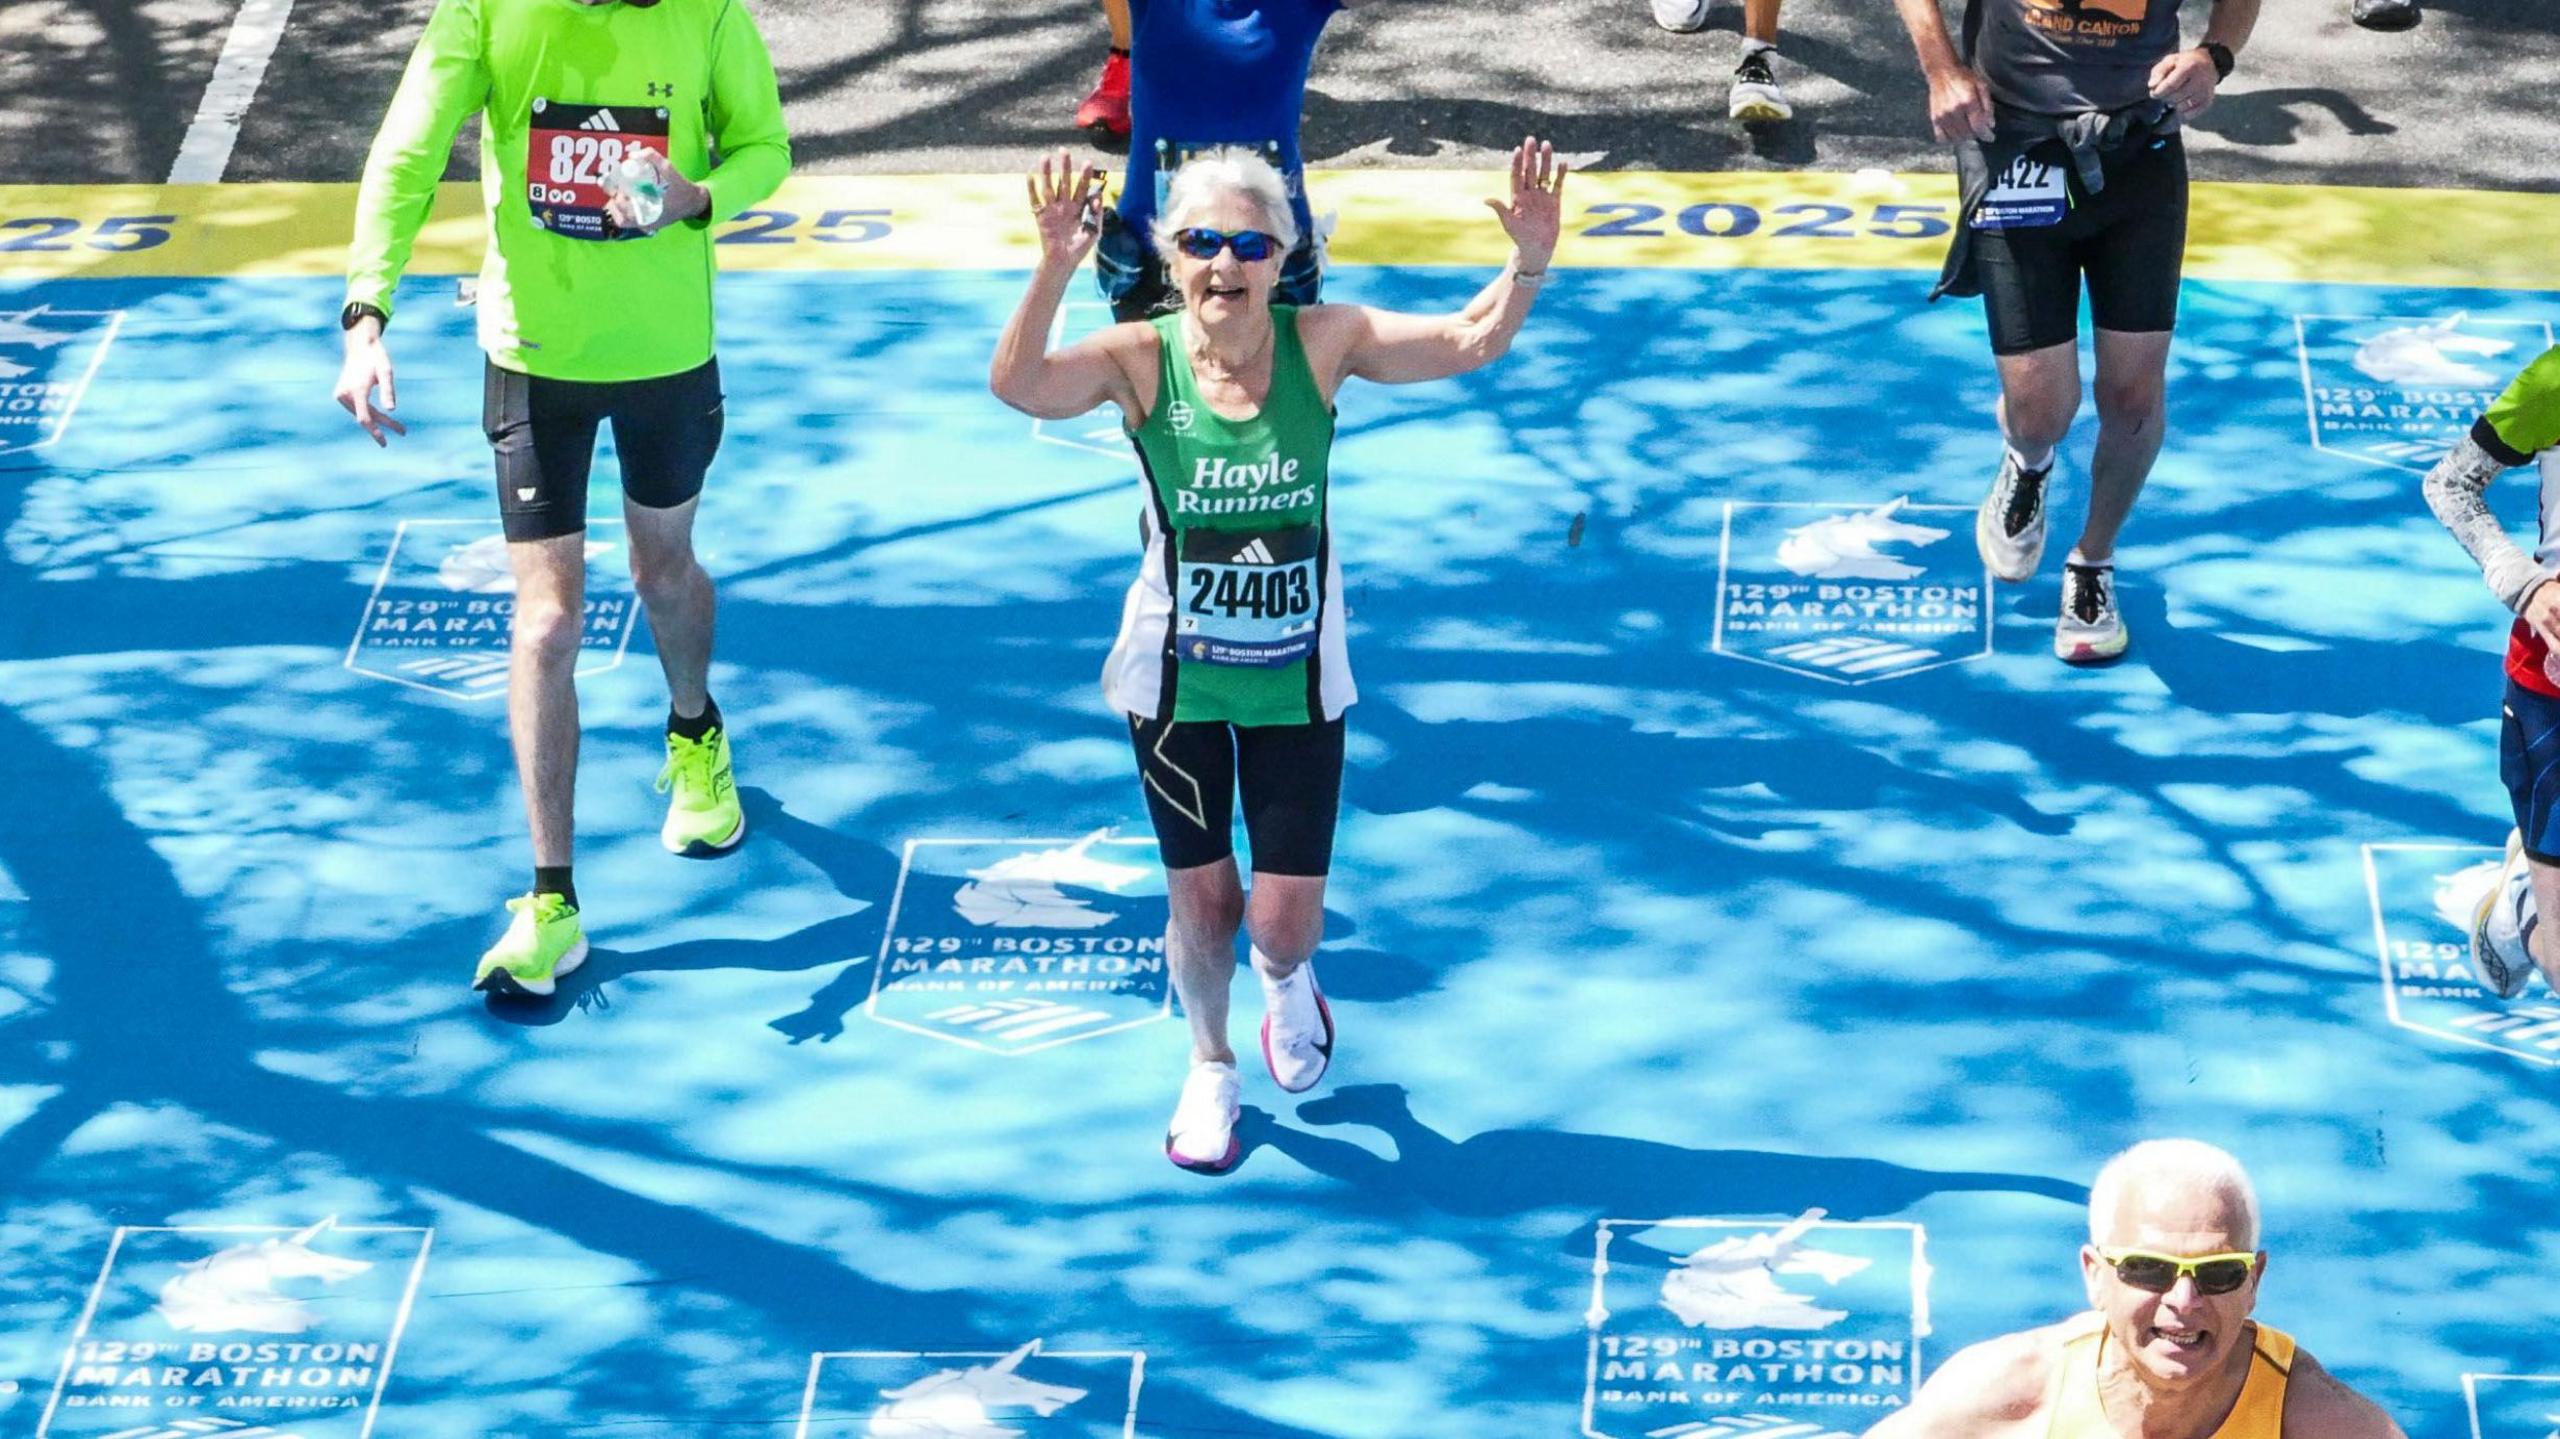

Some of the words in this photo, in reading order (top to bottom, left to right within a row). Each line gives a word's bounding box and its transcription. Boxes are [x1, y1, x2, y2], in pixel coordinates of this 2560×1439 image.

[2078, 21, 2140, 36] CANYON
[551, 135, 642, 184] 828
[1990, 157, 2050, 190] 422
[532, 186, 543, 198] 8
[575, 216, 602, 225] BOSTO
[1579, 203, 1951, 238] 2025
[2403, 391, 2496, 405] BOST
[2321, 404, 2486, 419] MARAT
[2404, 423, 2434, 432] OF
[1191, 452, 1298, 494] Hayle
[1176, 484, 1315, 514] Runners
[1190, 565, 1311, 619] 24403
[1818, 586, 1978, 601] BOSTON
[1729, 602, 1978, 618] MARATHON
[372, 618, 619, 631] MARAN
[1728, 621, 1800, 631] BANK
[1812, 622, 1847, 631] OF
[1858, 623, 1976, 633] AMERICA
[366, 637, 438, 647] BANK
[450, 637, 481, 646] OF
[1229, 648, 1262, 657] BOSTON
[1263, 642, 1307, 657] MARATHON
[992, 937, 1165, 954] BOSTON
[891, 957, 1162, 974] MARATHON
[888, 981, 966, 991] BANK
[977, 981, 1015, 991] OF
[1024, 980, 1156, 991] AMERICA
[2401, 987, 2482, 998] BANK
[188, 1343, 379, 1363] BOSTON
[1712, 1339, 1903, 1360] BOSTON
[71, 1366, 371, 1386] MARATHON
[1603, 1361, 1902, 1384] MARATHON
[65, 1395, 151, 1407] BANK
[165, 1395, 206, 1407] OF
[215, 1396, 359, 1408] AMERICA
[1602, 1391, 1690, 1403] BANK
[1702, 1392, 1745, 1403] OF
[1756, 1392, 1903, 1406] AMERICA
